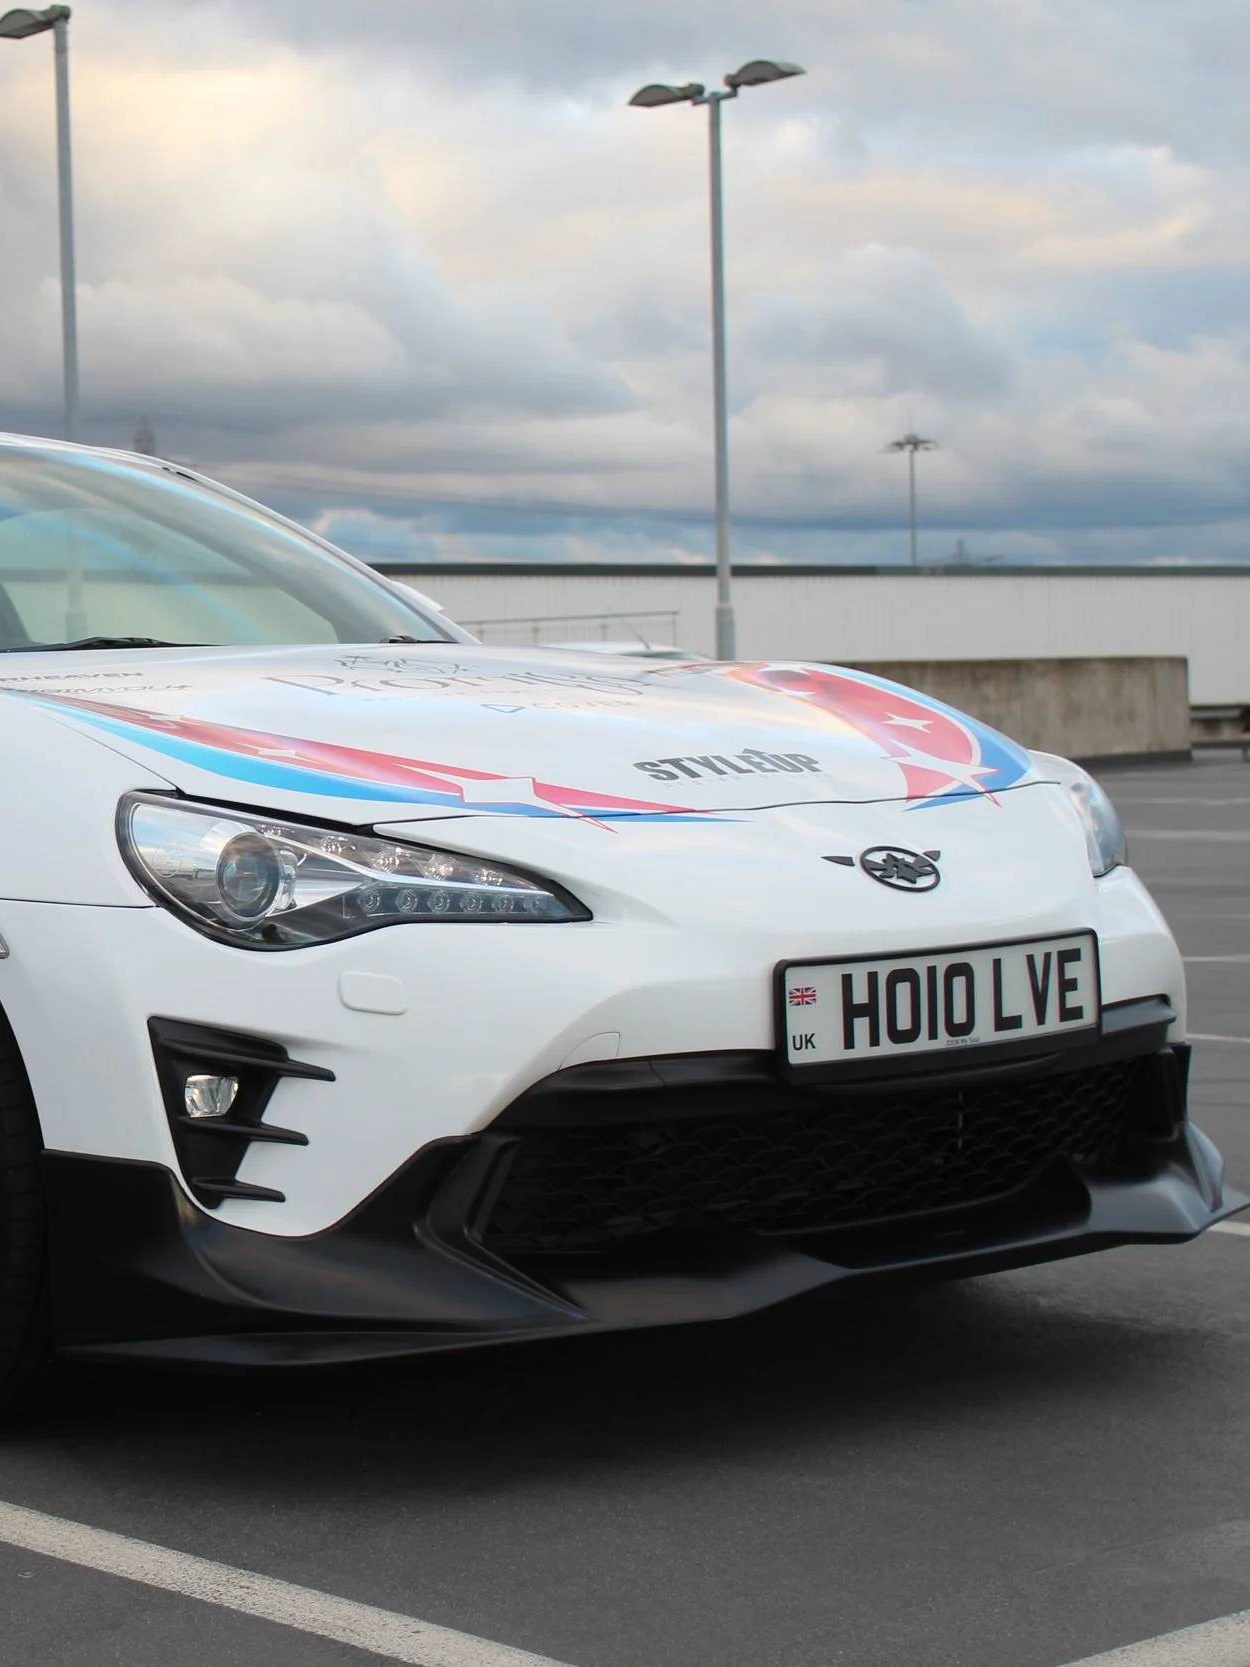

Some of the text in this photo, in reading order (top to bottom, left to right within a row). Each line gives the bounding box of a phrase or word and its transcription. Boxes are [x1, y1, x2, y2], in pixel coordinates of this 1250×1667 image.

[632, 748, 823, 782] STYLEUP
[993, 948, 1084, 1033] LVE
[792, 1033, 816, 1051] UK
